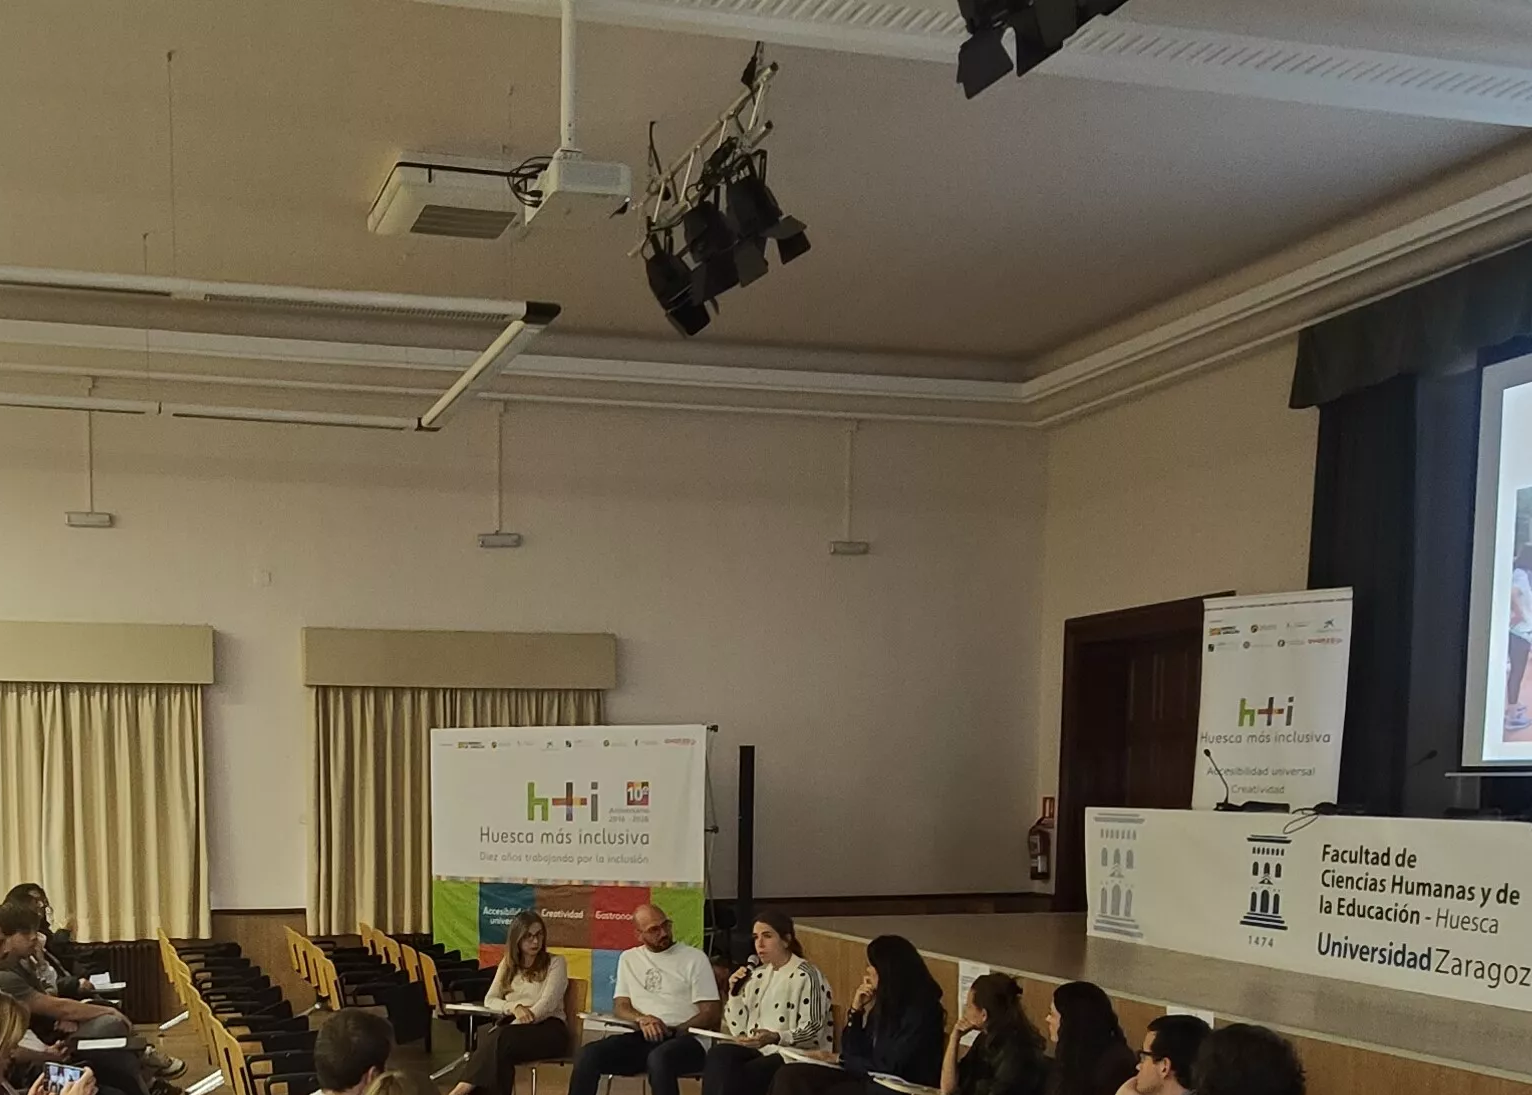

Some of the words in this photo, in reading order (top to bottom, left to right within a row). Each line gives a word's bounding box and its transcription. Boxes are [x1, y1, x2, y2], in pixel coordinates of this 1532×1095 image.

[1201, 732, 1242, 743] Huesca
[1275, 731, 1331, 743] inclusiva
[1207, 767, 1268, 776] Accesibilidad
[1272, 767, 1315, 776] universal
[1231, 784, 1285, 794] Creatividad
[480, 827, 534, 844] Huesca
[541, 828, 572, 845] más
[578, 828, 650, 845] inclusiva
[480, 852, 498, 862] Diez
[501, 853, 522, 863] años
[525, 853, 575, 865] trabajando
[577, 856, 592, 865] por
[596, 854, 605, 863] la
[607, 854, 649, 864] inclusión
[1321, 844, 1391, 867] Facultad
[1395, 848, 1417, 868] de
[1321, 870, 1386, 893] Ciencias
[1391, 875, 1475, 901] Humanas
[1479, 887, 1492, 908] y
[1496, 883, 1520, 905] de
[541, 908, 584, 919] Creatividad
[595, 911, 634, 920] Gastrono
[1319, 895, 1332, 914] la
[1337, 898, 1420, 925] Educación
[1435, 908, 1499, 934] Huesca
[490, 917, 513, 925] univer
[1248, 935, 1273, 948] 1474
[1318, 932, 1432, 971] Universidad
[1434, 948, 1532, 989] Zaragoz
